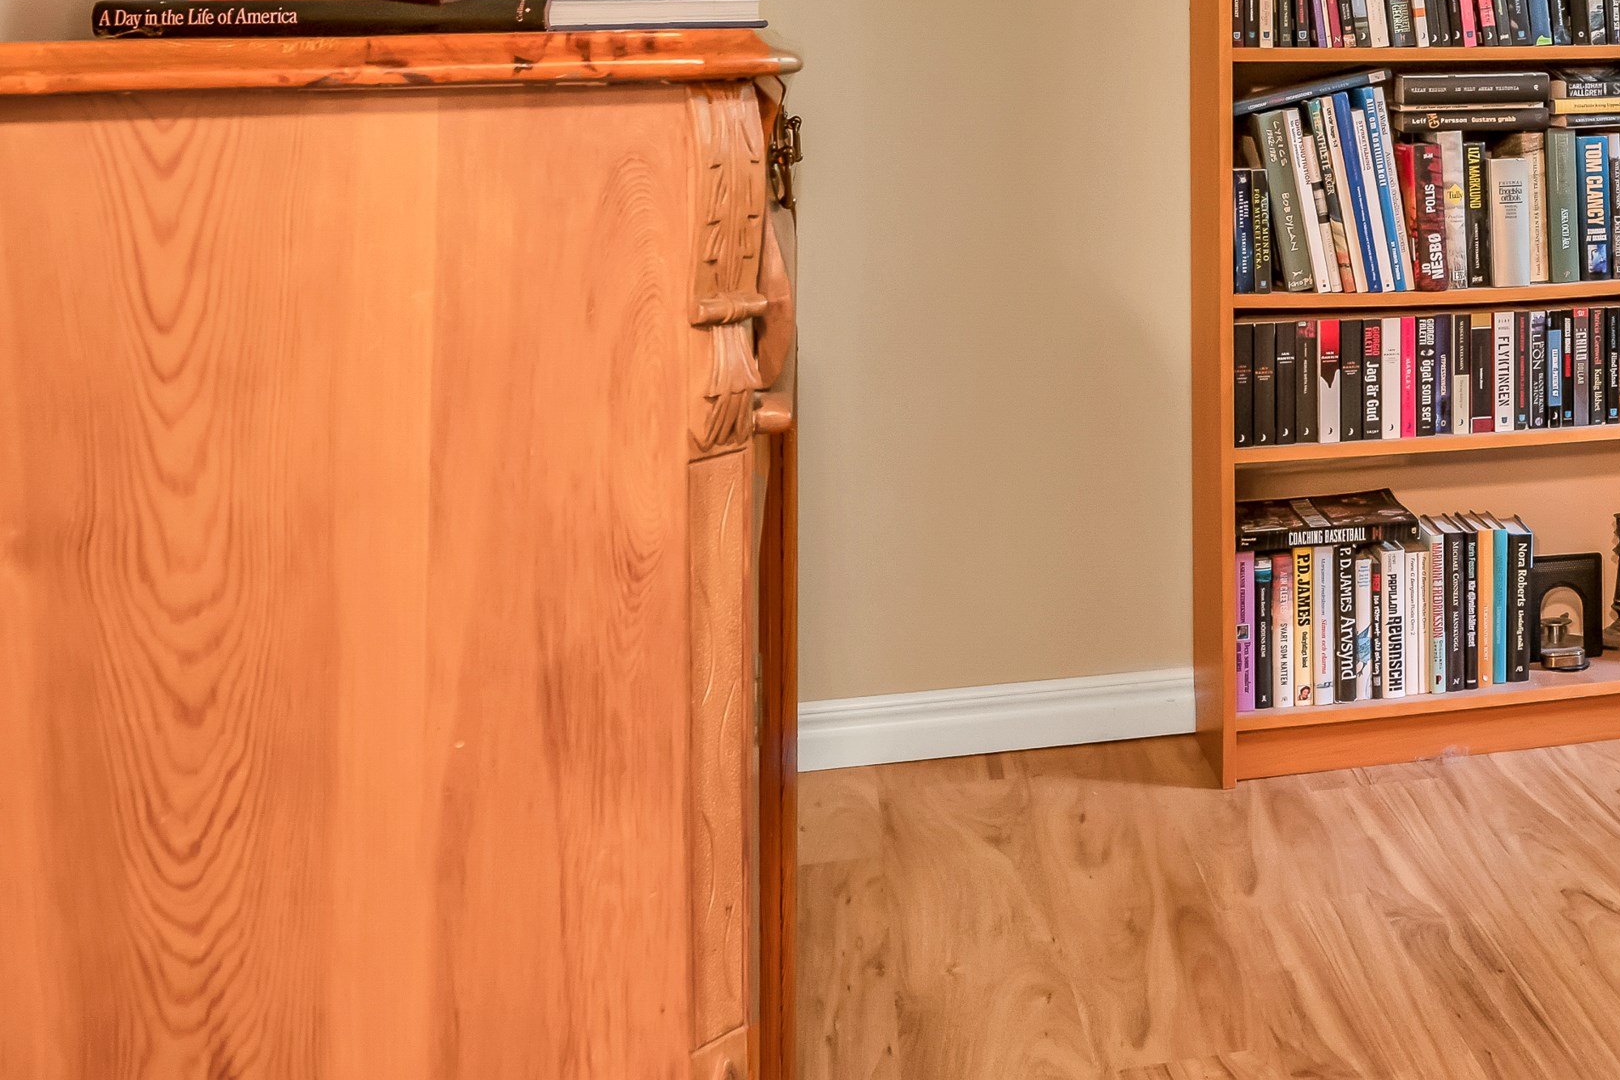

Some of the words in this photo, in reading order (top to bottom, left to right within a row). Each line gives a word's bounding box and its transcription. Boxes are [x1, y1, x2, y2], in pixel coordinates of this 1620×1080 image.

[99, 9, 110, 26] A
[115, 9, 142, 29] Day
[145, 9, 158, 26] in
[161, 9, 184, 25] the
[188, 8, 214, 25] Life
[218, 7, 235, 24] of
[235, 7, 298, 24] America
[515, 0, 526, 23] Collins
[1570, 89, 1604, 98] VALLGREN
[1467, 147, 1479, 163] LIZA
[1585, 142, 1603, 172] TOM
[1425, 184, 1436, 213] POLIS
[1447, 192, 1463, 201] Tully
[1468, 165, 1481, 208] MARKLUND
[1281, 192, 1291, 213] BOB
[1586, 175, 1605, 226] CLANCY
[1285, 215, 1298, 251] DYLAN
[1421, 263, 1431, 276] JO
[1429, 234, 1444, 279] NESBØ
[1364, 327, 1373, 356] FALETTI
[1372, 327, 1380, 356] GIORGIO
[1419, 318, 1427, 345] FALETTI
[1426, 318, 1434, 345] GIORGIO
[1365, 361, 1379, 382] Jag
[1420, 359, 1434, 382] ögat
[1498, 336, 1510, 407] FLYKTINGEN
[1366, 385, 1379, 397] är
[1422, 384, 1431, 404] som
[1367, 400, 1380, 421] Gud
[1422, 406, 1431, 422] ser
[1288, 529, 1323, 546] COACHING
[1325, 526, 1367, 543] BASKETBALL
[1432, 542, 1444, 582] MARIANNE
[1517, 542, 1528, 566] Nora
[1340, 570, 1354, 611] JAMES
[1386, 573, 1401, 614] PAPILLON
[1516, 569, 1527, 606] Roberts
[1298, 578, 1312, 626] JAMES
[1432, 585, 1444, 638] FREDRIKSSON
[1279, 623, 1288, 643] SVART
[1279, 645, 1288, 657] SOM
[1339, 615, 1356, 679] Arvsynd
[1387, 616, 1405, 691] REVANSCH!
[1280, 661, 1288, 685] NATTEN
